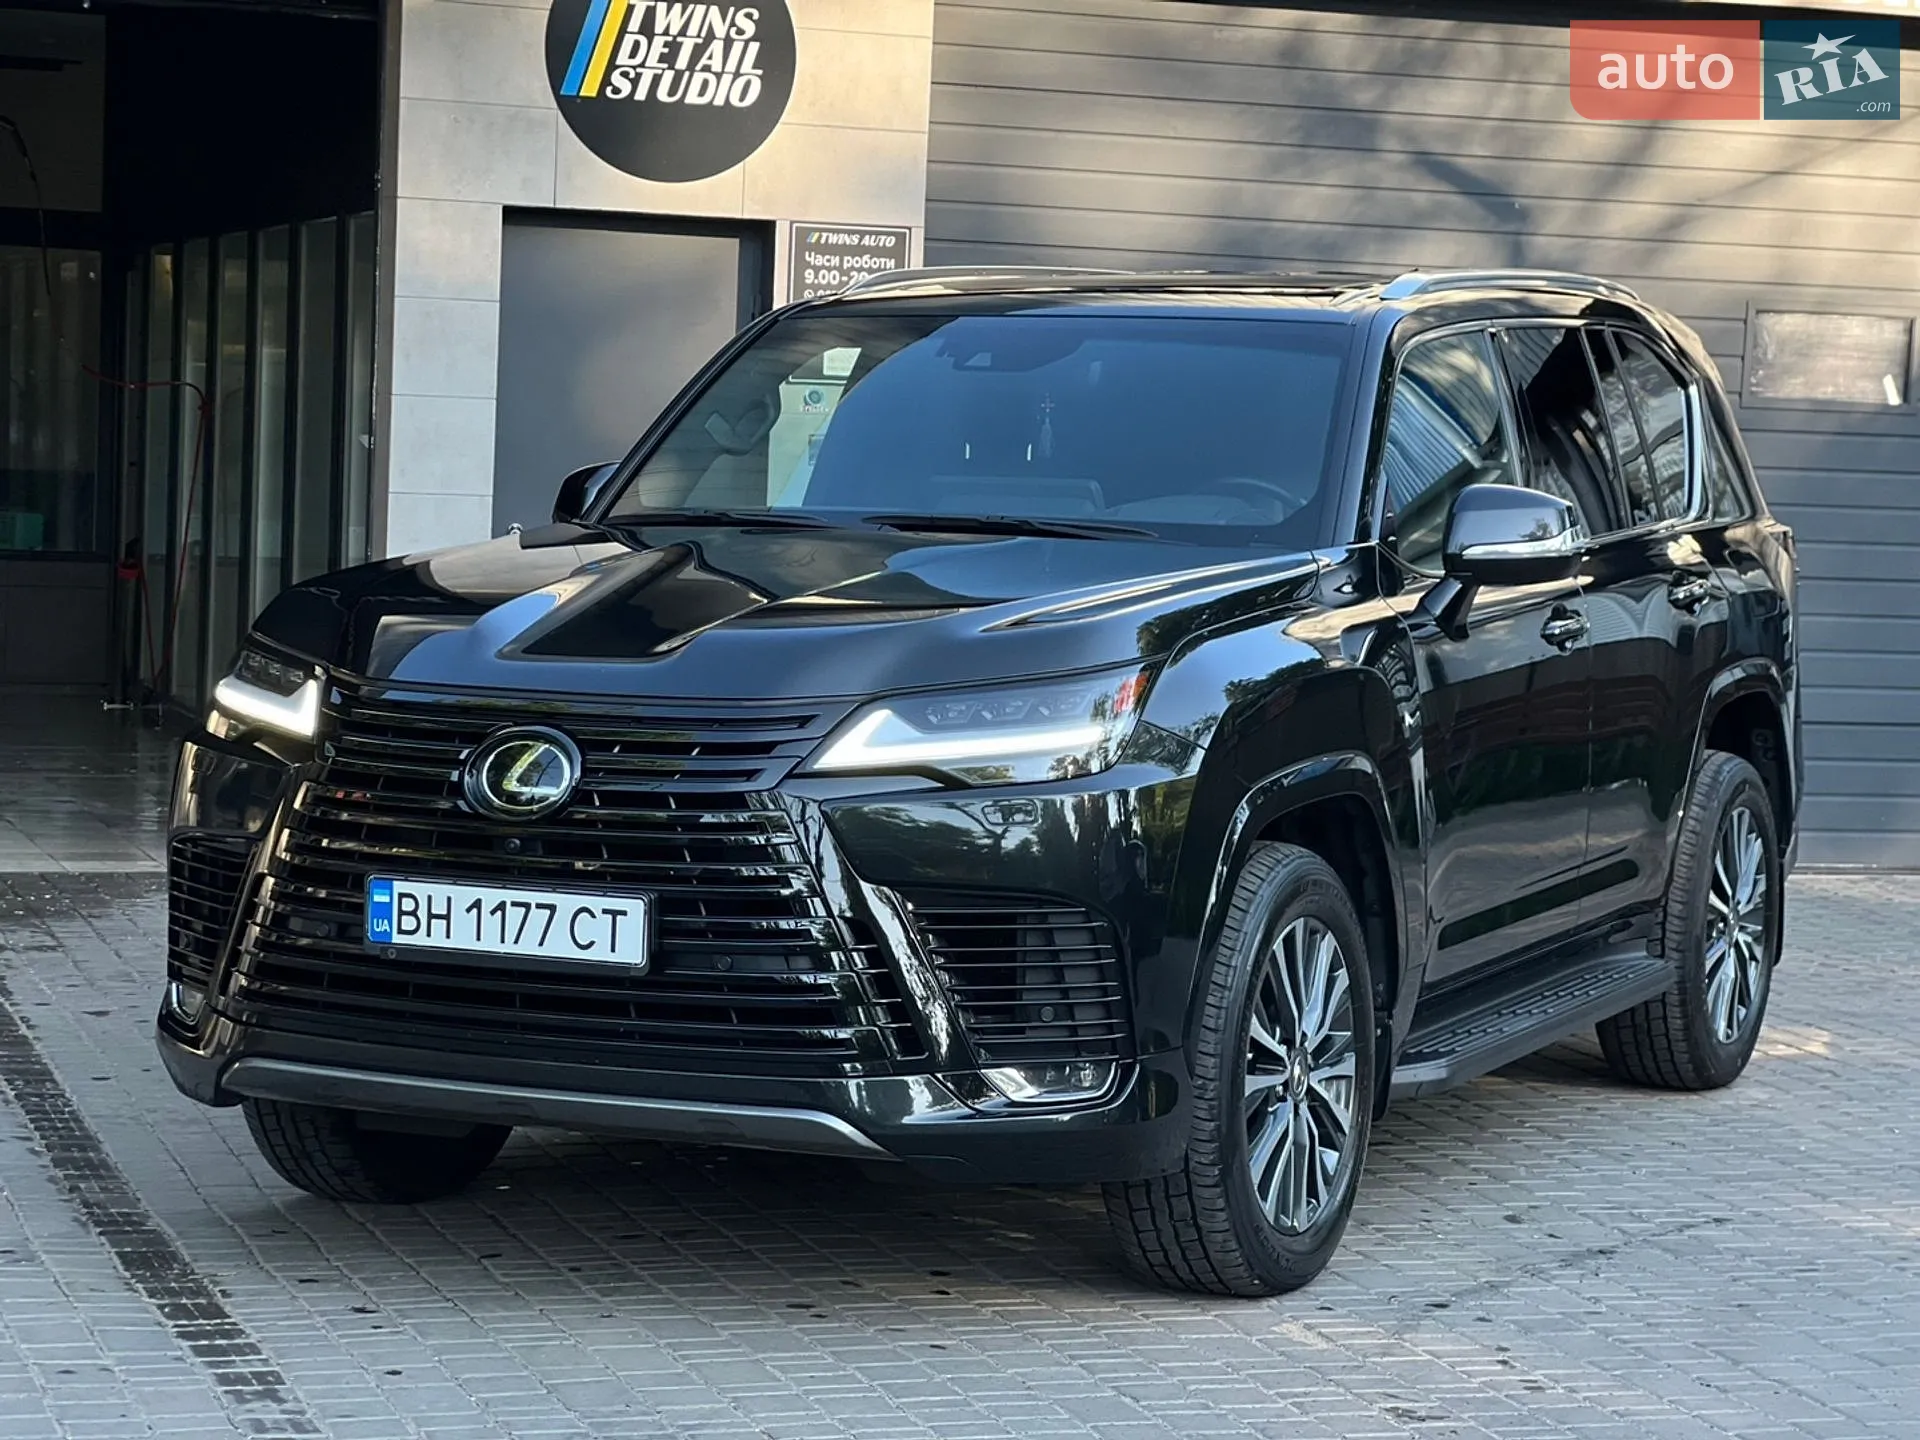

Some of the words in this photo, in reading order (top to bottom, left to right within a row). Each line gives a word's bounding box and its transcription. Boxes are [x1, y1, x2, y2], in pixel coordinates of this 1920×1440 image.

[626, 1, 760, 40] TWINS
[615, 33, 763, 75] DETAIL
[605, 67, 762, 107] STUDIO
[820, 232, 860, 246] TWINS
[861, 235, 896, 248] AUTO
[805, 251, 840, 266] Часи
[843, 254, 896, 270] роботи
[373, 918, 391, 933] UA
[396, 892, 452, 939] BH
[465, 898, 558, 948] 1177
[569, 906, 628, 953] CT
